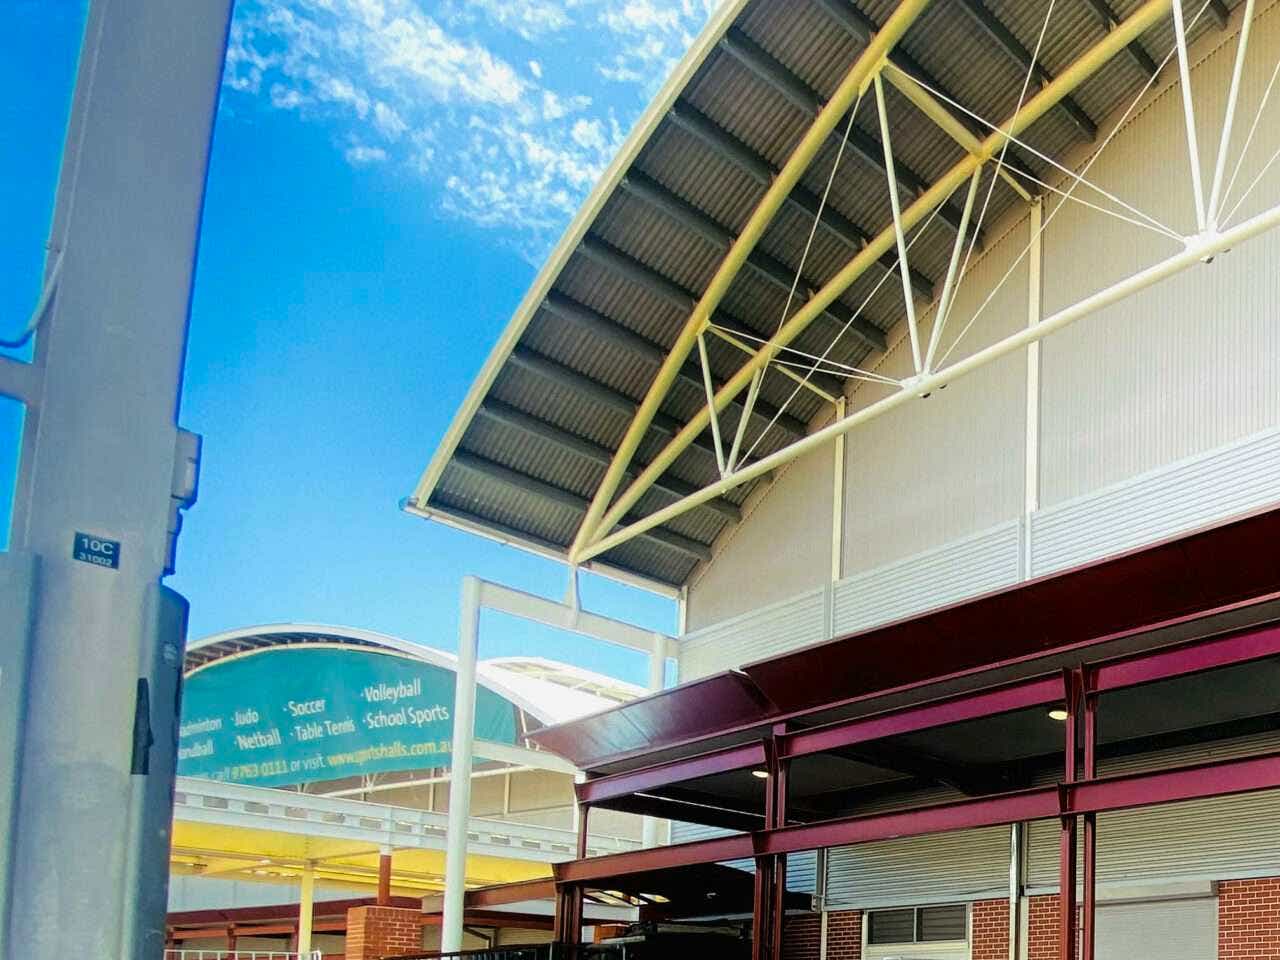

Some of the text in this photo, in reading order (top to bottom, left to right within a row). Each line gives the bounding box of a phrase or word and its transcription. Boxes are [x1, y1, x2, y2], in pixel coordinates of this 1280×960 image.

[81, 538, 113, 555] 10C
[364, 678, 421, 704] Volleyball
[234, 708, 259, 727] Judo
[288, 699, 326, 717] Soccer
[367, 704, 449, 730] School Sports
[237, 728, 281, 751] Netball
[294, 715, 356, 741] Table Tennis
